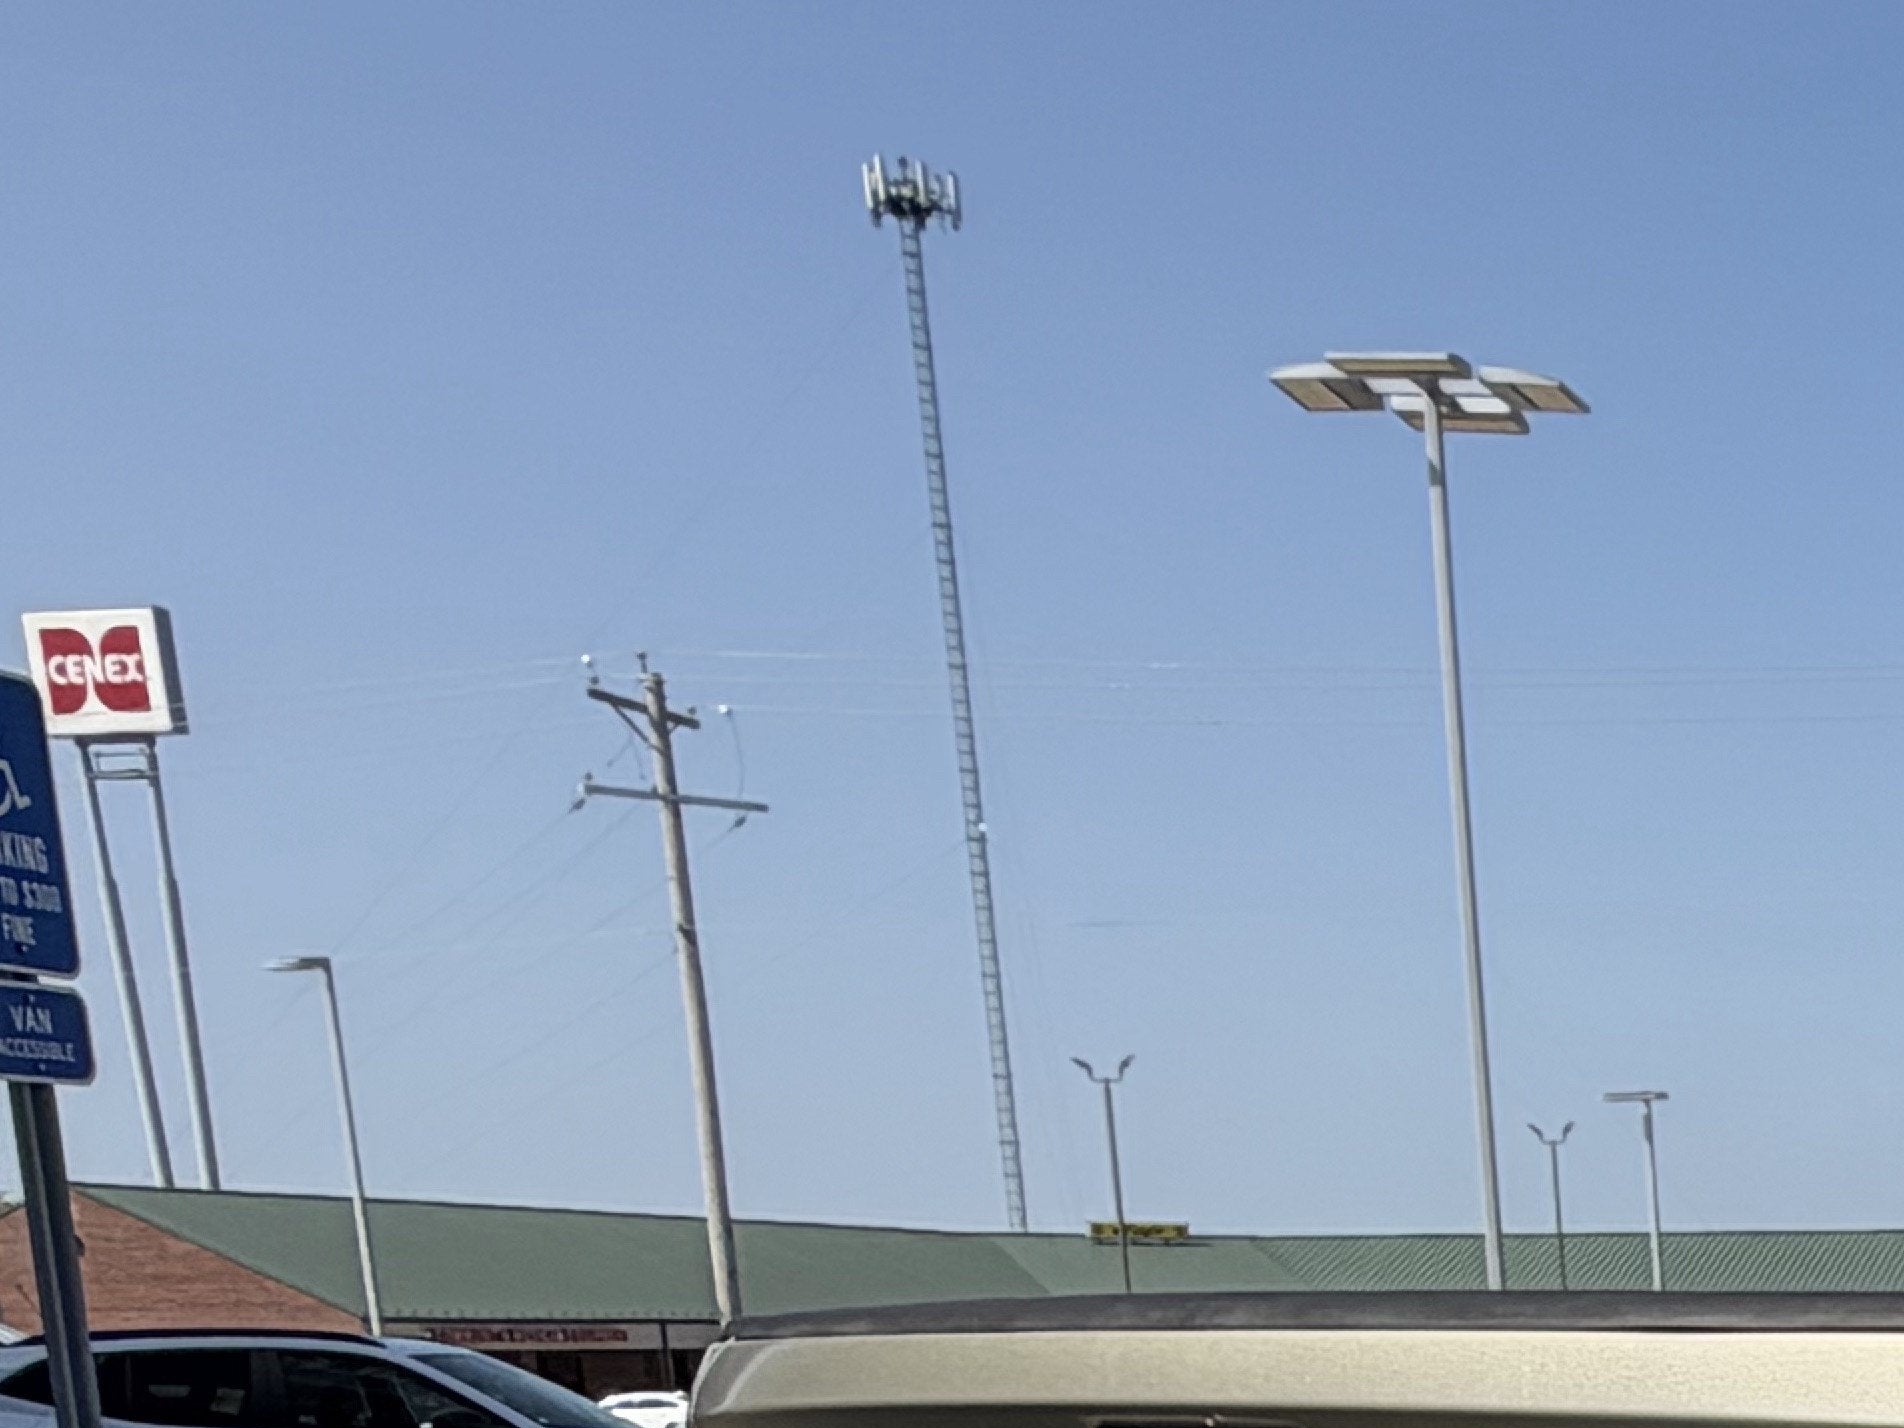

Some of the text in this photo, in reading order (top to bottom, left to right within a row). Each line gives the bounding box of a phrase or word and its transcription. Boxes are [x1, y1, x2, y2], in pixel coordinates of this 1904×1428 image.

[48, 652, 145, 685] CENEX
[0, 830, 49, 874] KING
[8, 1004, 53, 1034] VAN
